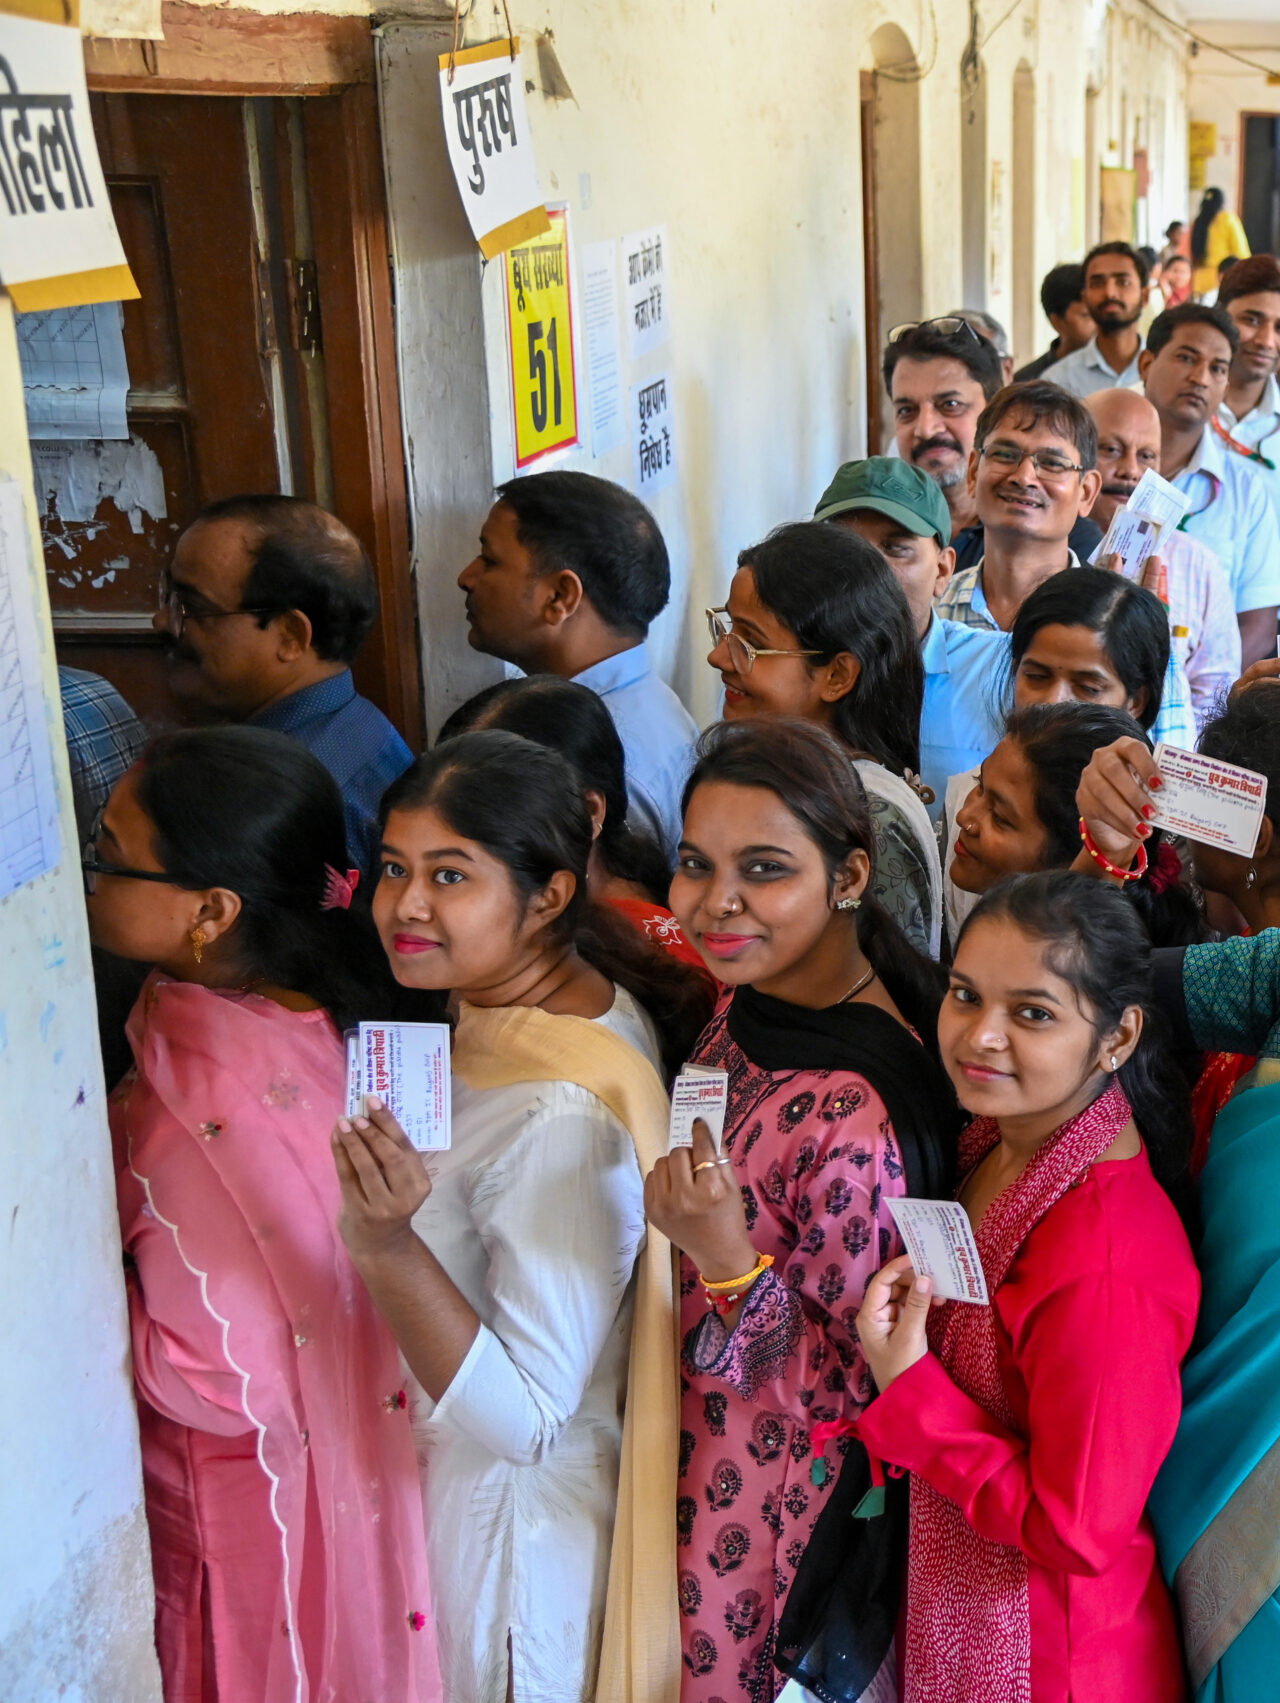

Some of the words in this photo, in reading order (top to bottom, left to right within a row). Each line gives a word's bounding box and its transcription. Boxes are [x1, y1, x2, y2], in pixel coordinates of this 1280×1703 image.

[0, 53, 94, 216] हिला
[527, 317, 562, 433] 51
[1220, 775, 1240, 789] कुमार
[373, 1030, 385, 1055] त्रिपाठी
[376, 1056, 389, 1077] कुमार
